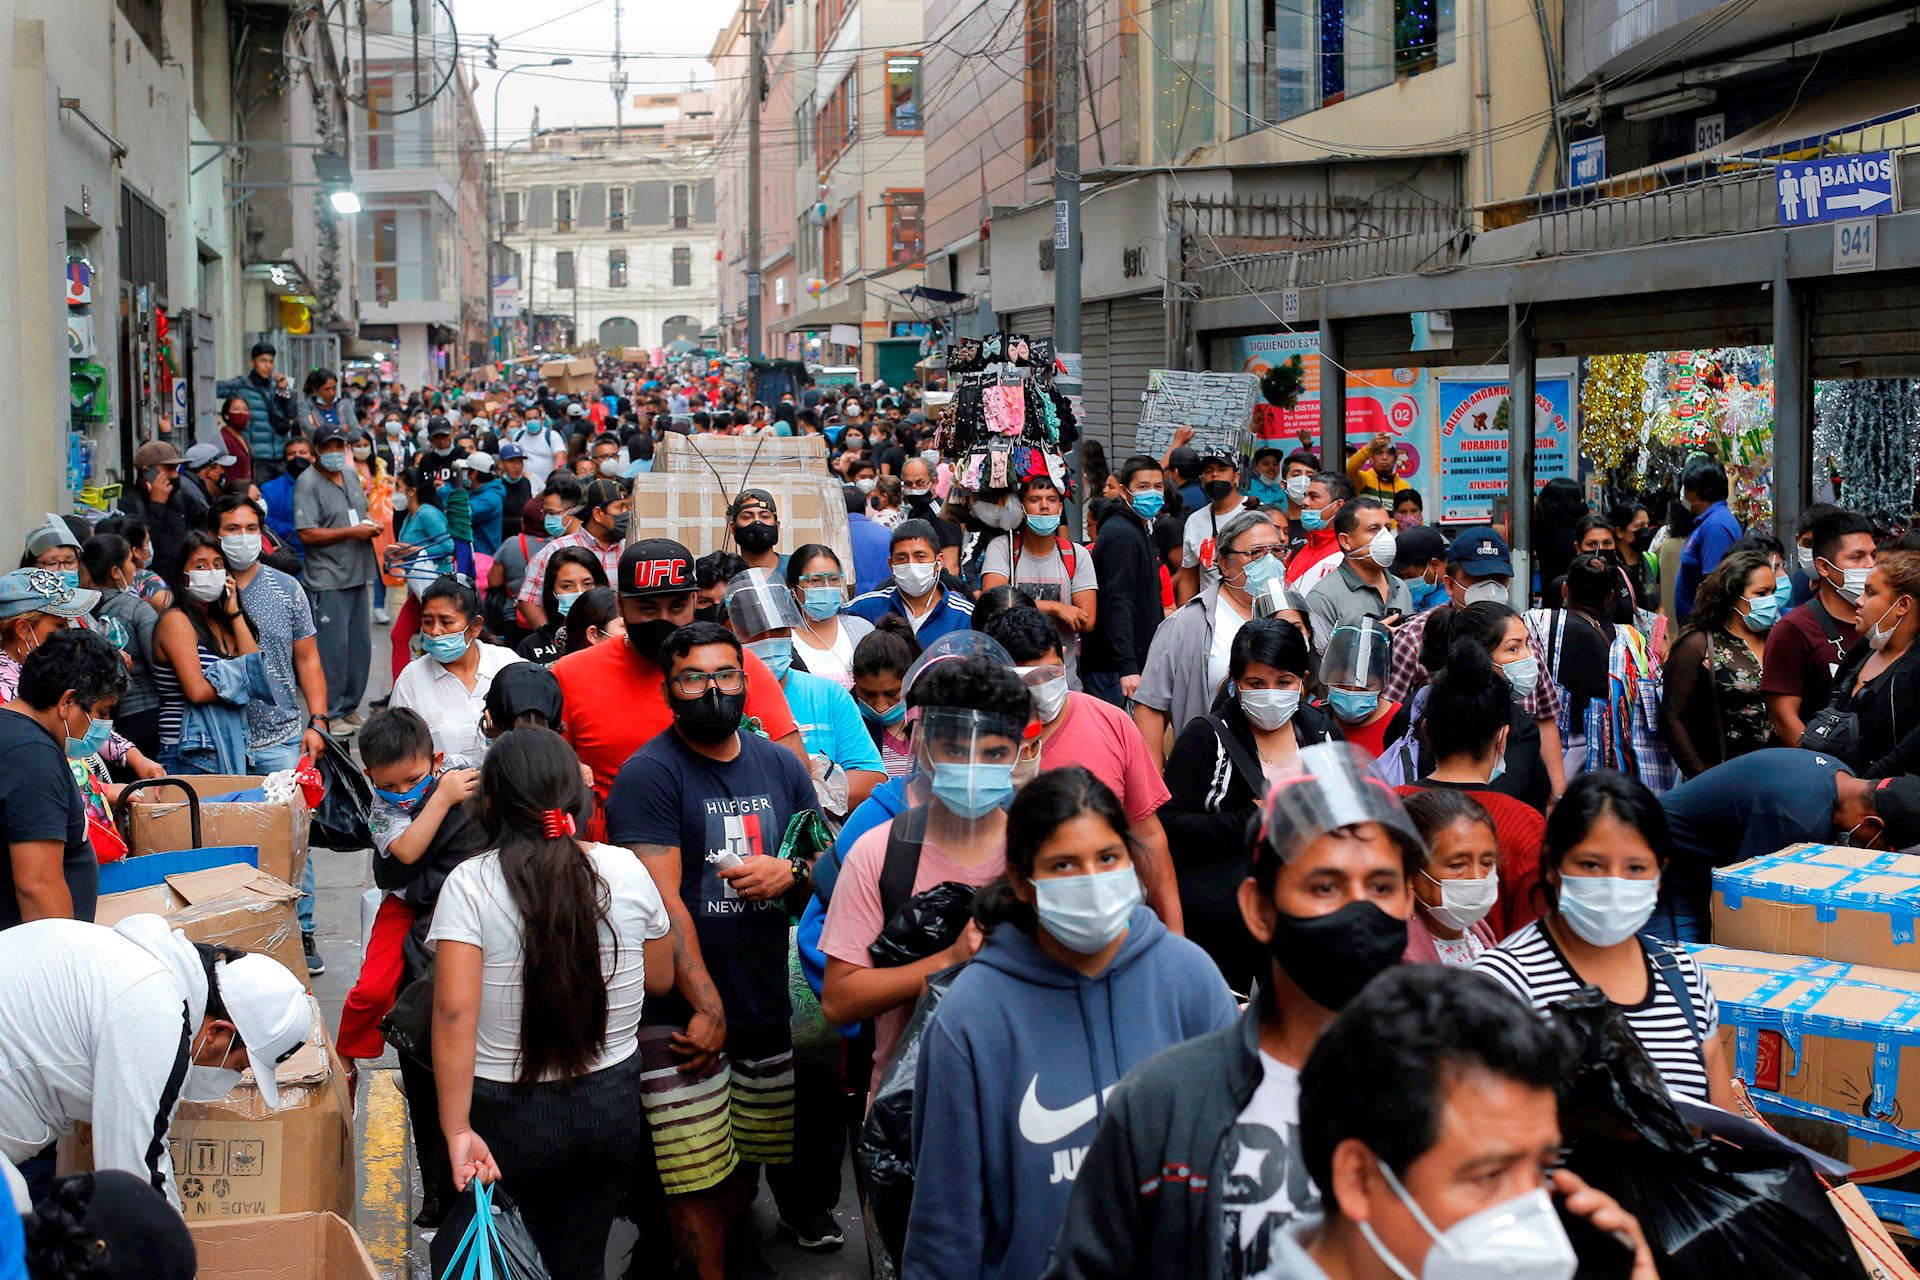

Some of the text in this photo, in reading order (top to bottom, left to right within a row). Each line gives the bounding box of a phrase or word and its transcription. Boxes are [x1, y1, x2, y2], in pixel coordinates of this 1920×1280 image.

[1698, 124, 1722, 151] 935
[1819, 157, 1891, 188] BAÑOS
[1841, 225, 1870, 256] 941
[1285, 293, 1297, 311] 935
[1249, 338, 1320, 351] SIGUIENDO ESTA
[1294, 404, 1320, 412] DISTAN
[1394, 410, 1410, 421] 02
[1443, 400, 1471, 436] GALERIA
[1535, 394, 1553, 413] 935
[1553, 415, 1568, 433] 941
[1461, 438, 1557, 451] HORARIO D CIÓN:
[1469, 479, 1501, 489] ATENCIÓN
[634, 559, 687, 589] UFC
[707, 898, 784, 914] NEW YO
[196, 1201, 212, 1214] IN
[221, 1201, 266, 1215] MADE
